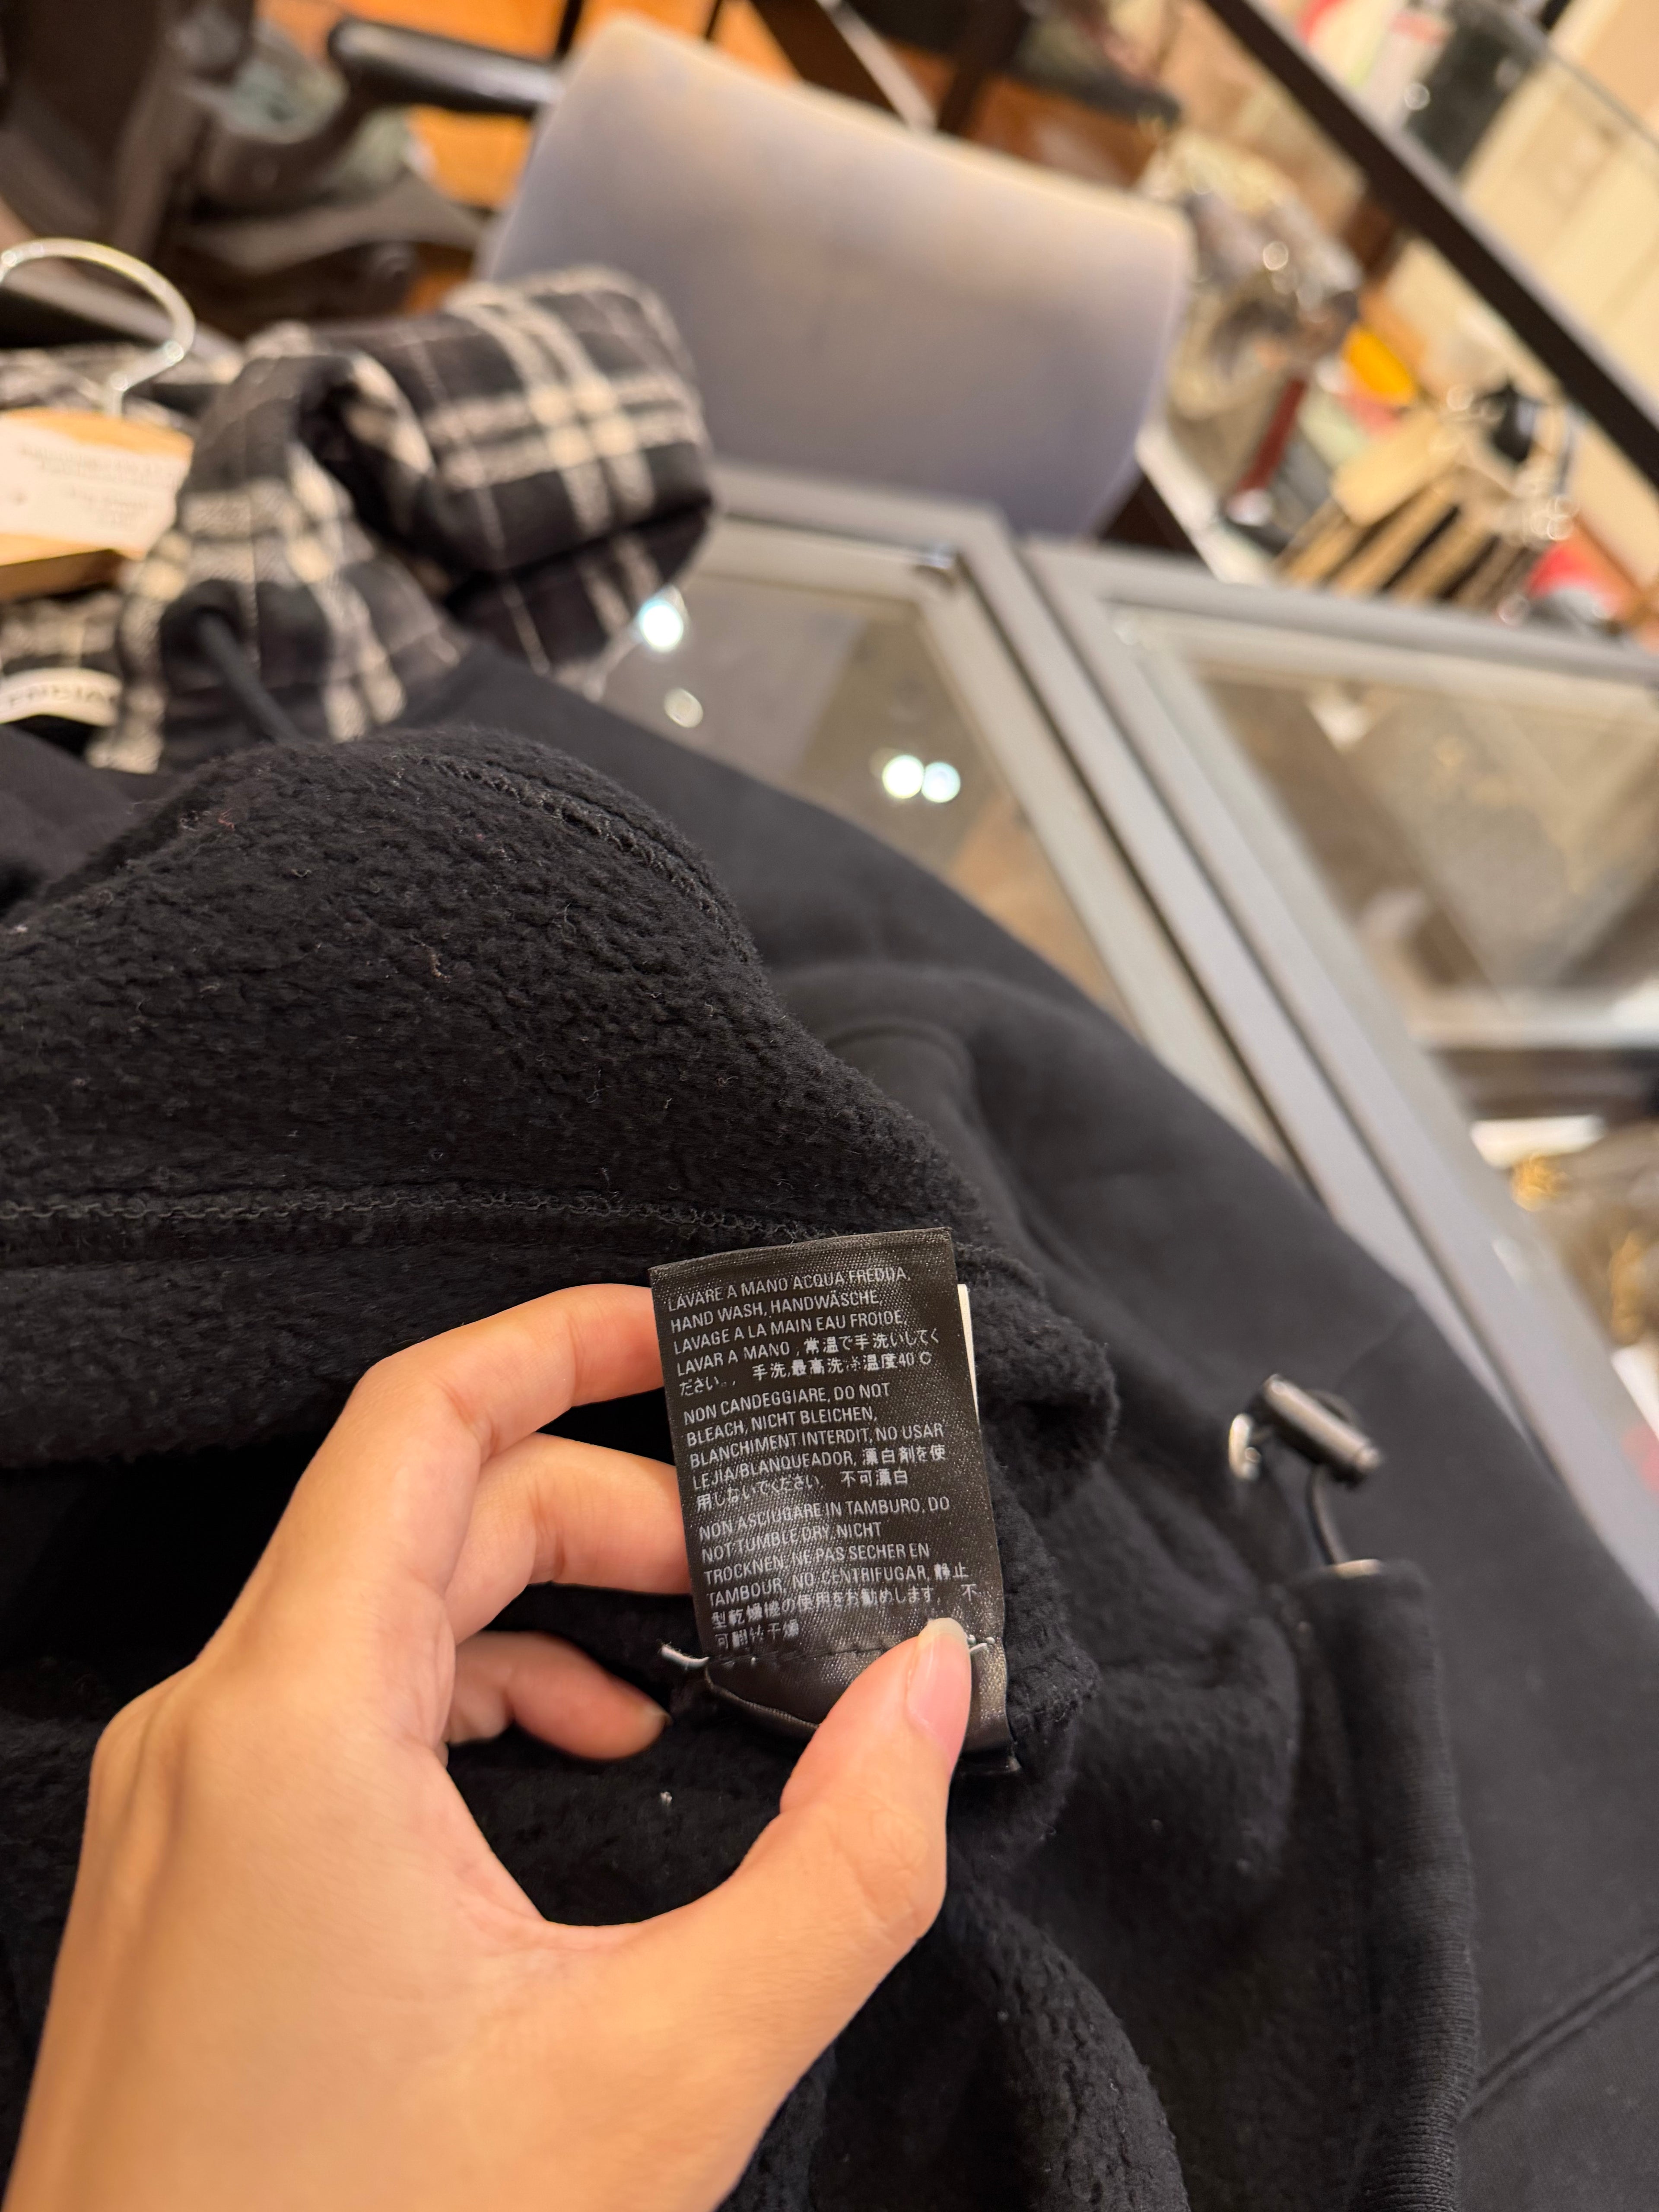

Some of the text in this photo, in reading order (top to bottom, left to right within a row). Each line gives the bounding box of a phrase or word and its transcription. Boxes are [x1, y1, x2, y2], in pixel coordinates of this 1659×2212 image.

[669, 1287, 724, 1311] LAVARE
[728, 1285, 737, 1299] A
[741, 1278, 788, 1296] MANO
[793, 1271, 845, 1290] ACQUA
[671, 1311, 713, 1333] HAND
[718, 1302, 767, 1322] WASH,
[674, 1310, 907, 1355] LAVAGE A LA MAIN EAU FROIDE,
[677, 1352, 724, 1376] LAVAR
[728, 1350, 738, 1364] A
[683, 1382, 890, 1425] NON CANDEGGIARE, DO NOT
[686, 1406, 877, 1447] BLEACH, NICHT BLEICHEN,
[690, 1423, 944, 1469] BLANCHIMENT INTERDIT, NO USAR
[693, 1450, 856, 1490] LEJIA/BLANQUEADOR,
[699, 1520, 733, 1541] NON
[738, 1502, 821, 1531] ASCIUGARE
[825, 1502, 842, 1516] IN
[928, 1496, 950, 1512] DO
[702, 1542, 732, 1564] NOT
[735, 1528, 798, 1554] TUMBLE
[836, 1522, 881, 1538] NICHT
[792, 1548, 810, 1567] NE
[816, 1546, 845, 1563] PAS
[849, 1543, 906, 1560] SECHER
[909, 1543, 929, 1558] EN
[792, 1572, 814, 1589] NO
[961, 1583, 977, 1602] 不
